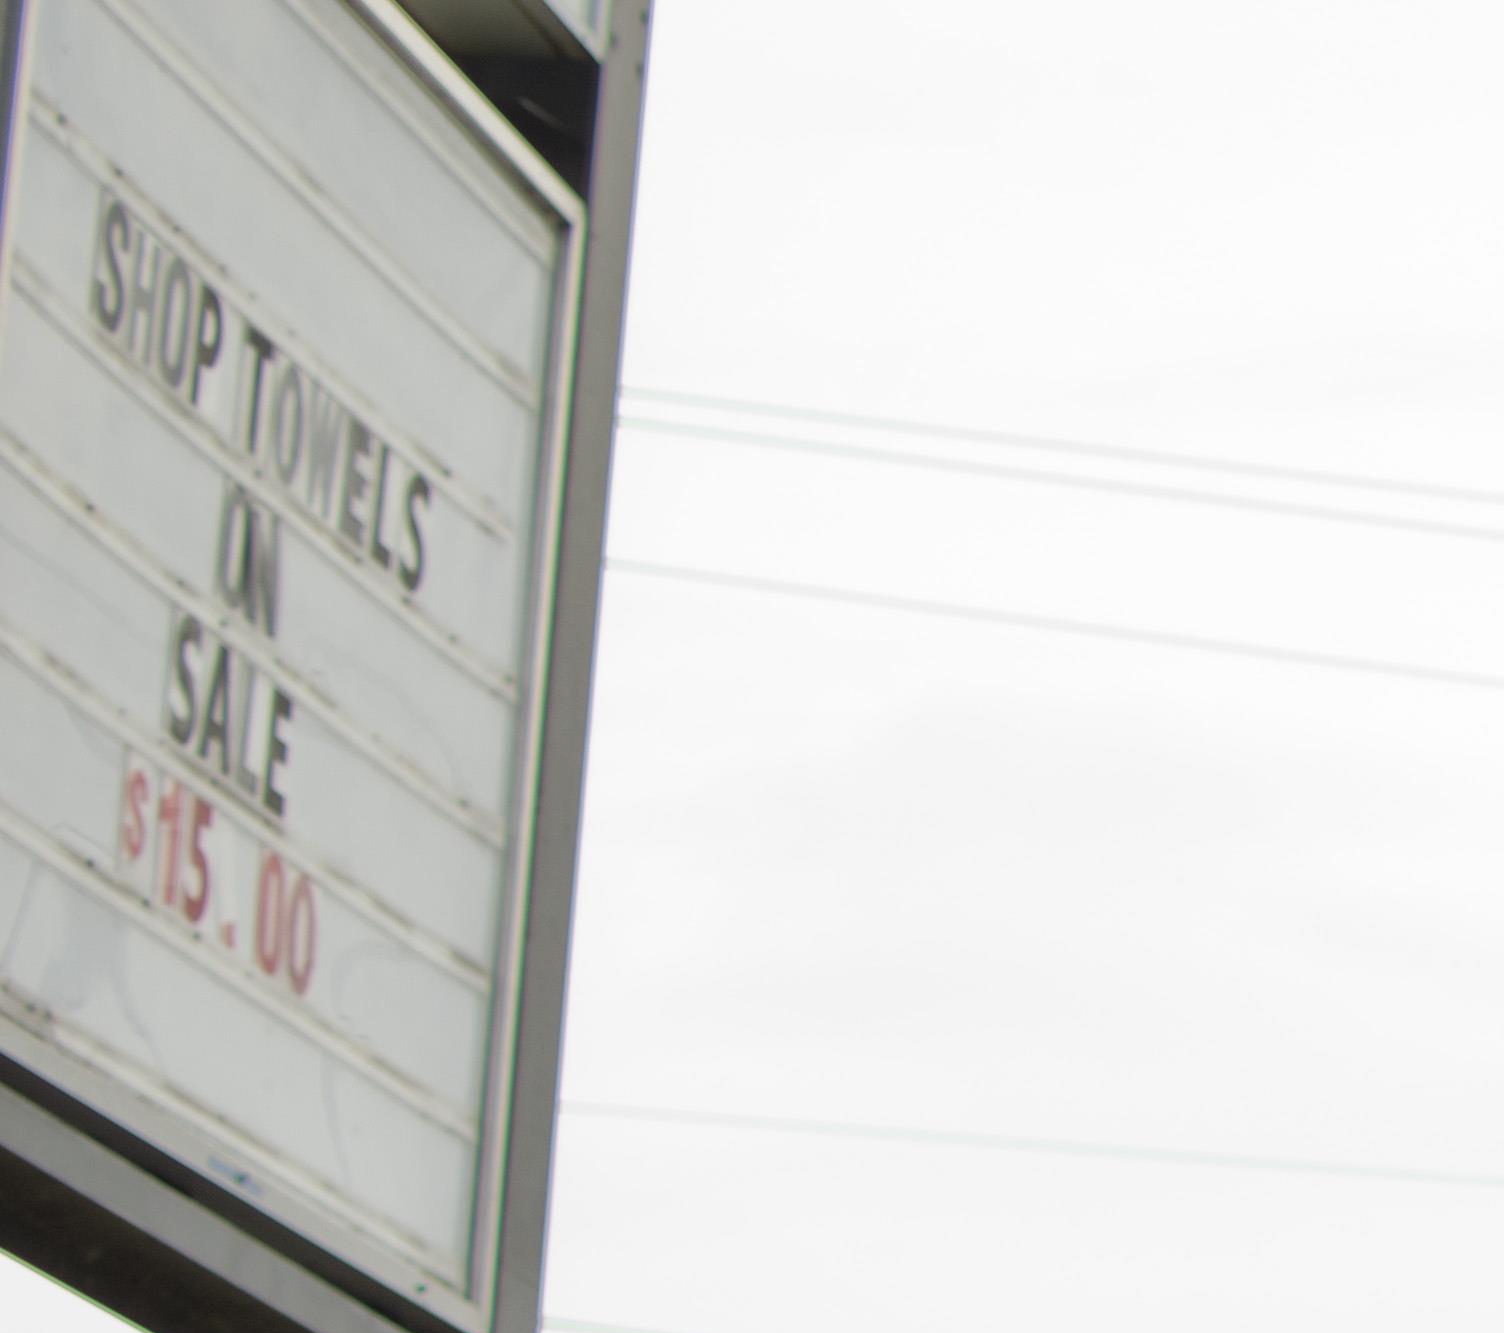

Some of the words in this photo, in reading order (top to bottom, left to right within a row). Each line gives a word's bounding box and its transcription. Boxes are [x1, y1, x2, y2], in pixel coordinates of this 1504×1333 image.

[93, 202, 223, 406] SHOP
[246, 322, 429, 592] TOWELS
[219, 488, 279, 638] ON
[170, 614, 292, 817] SALE
